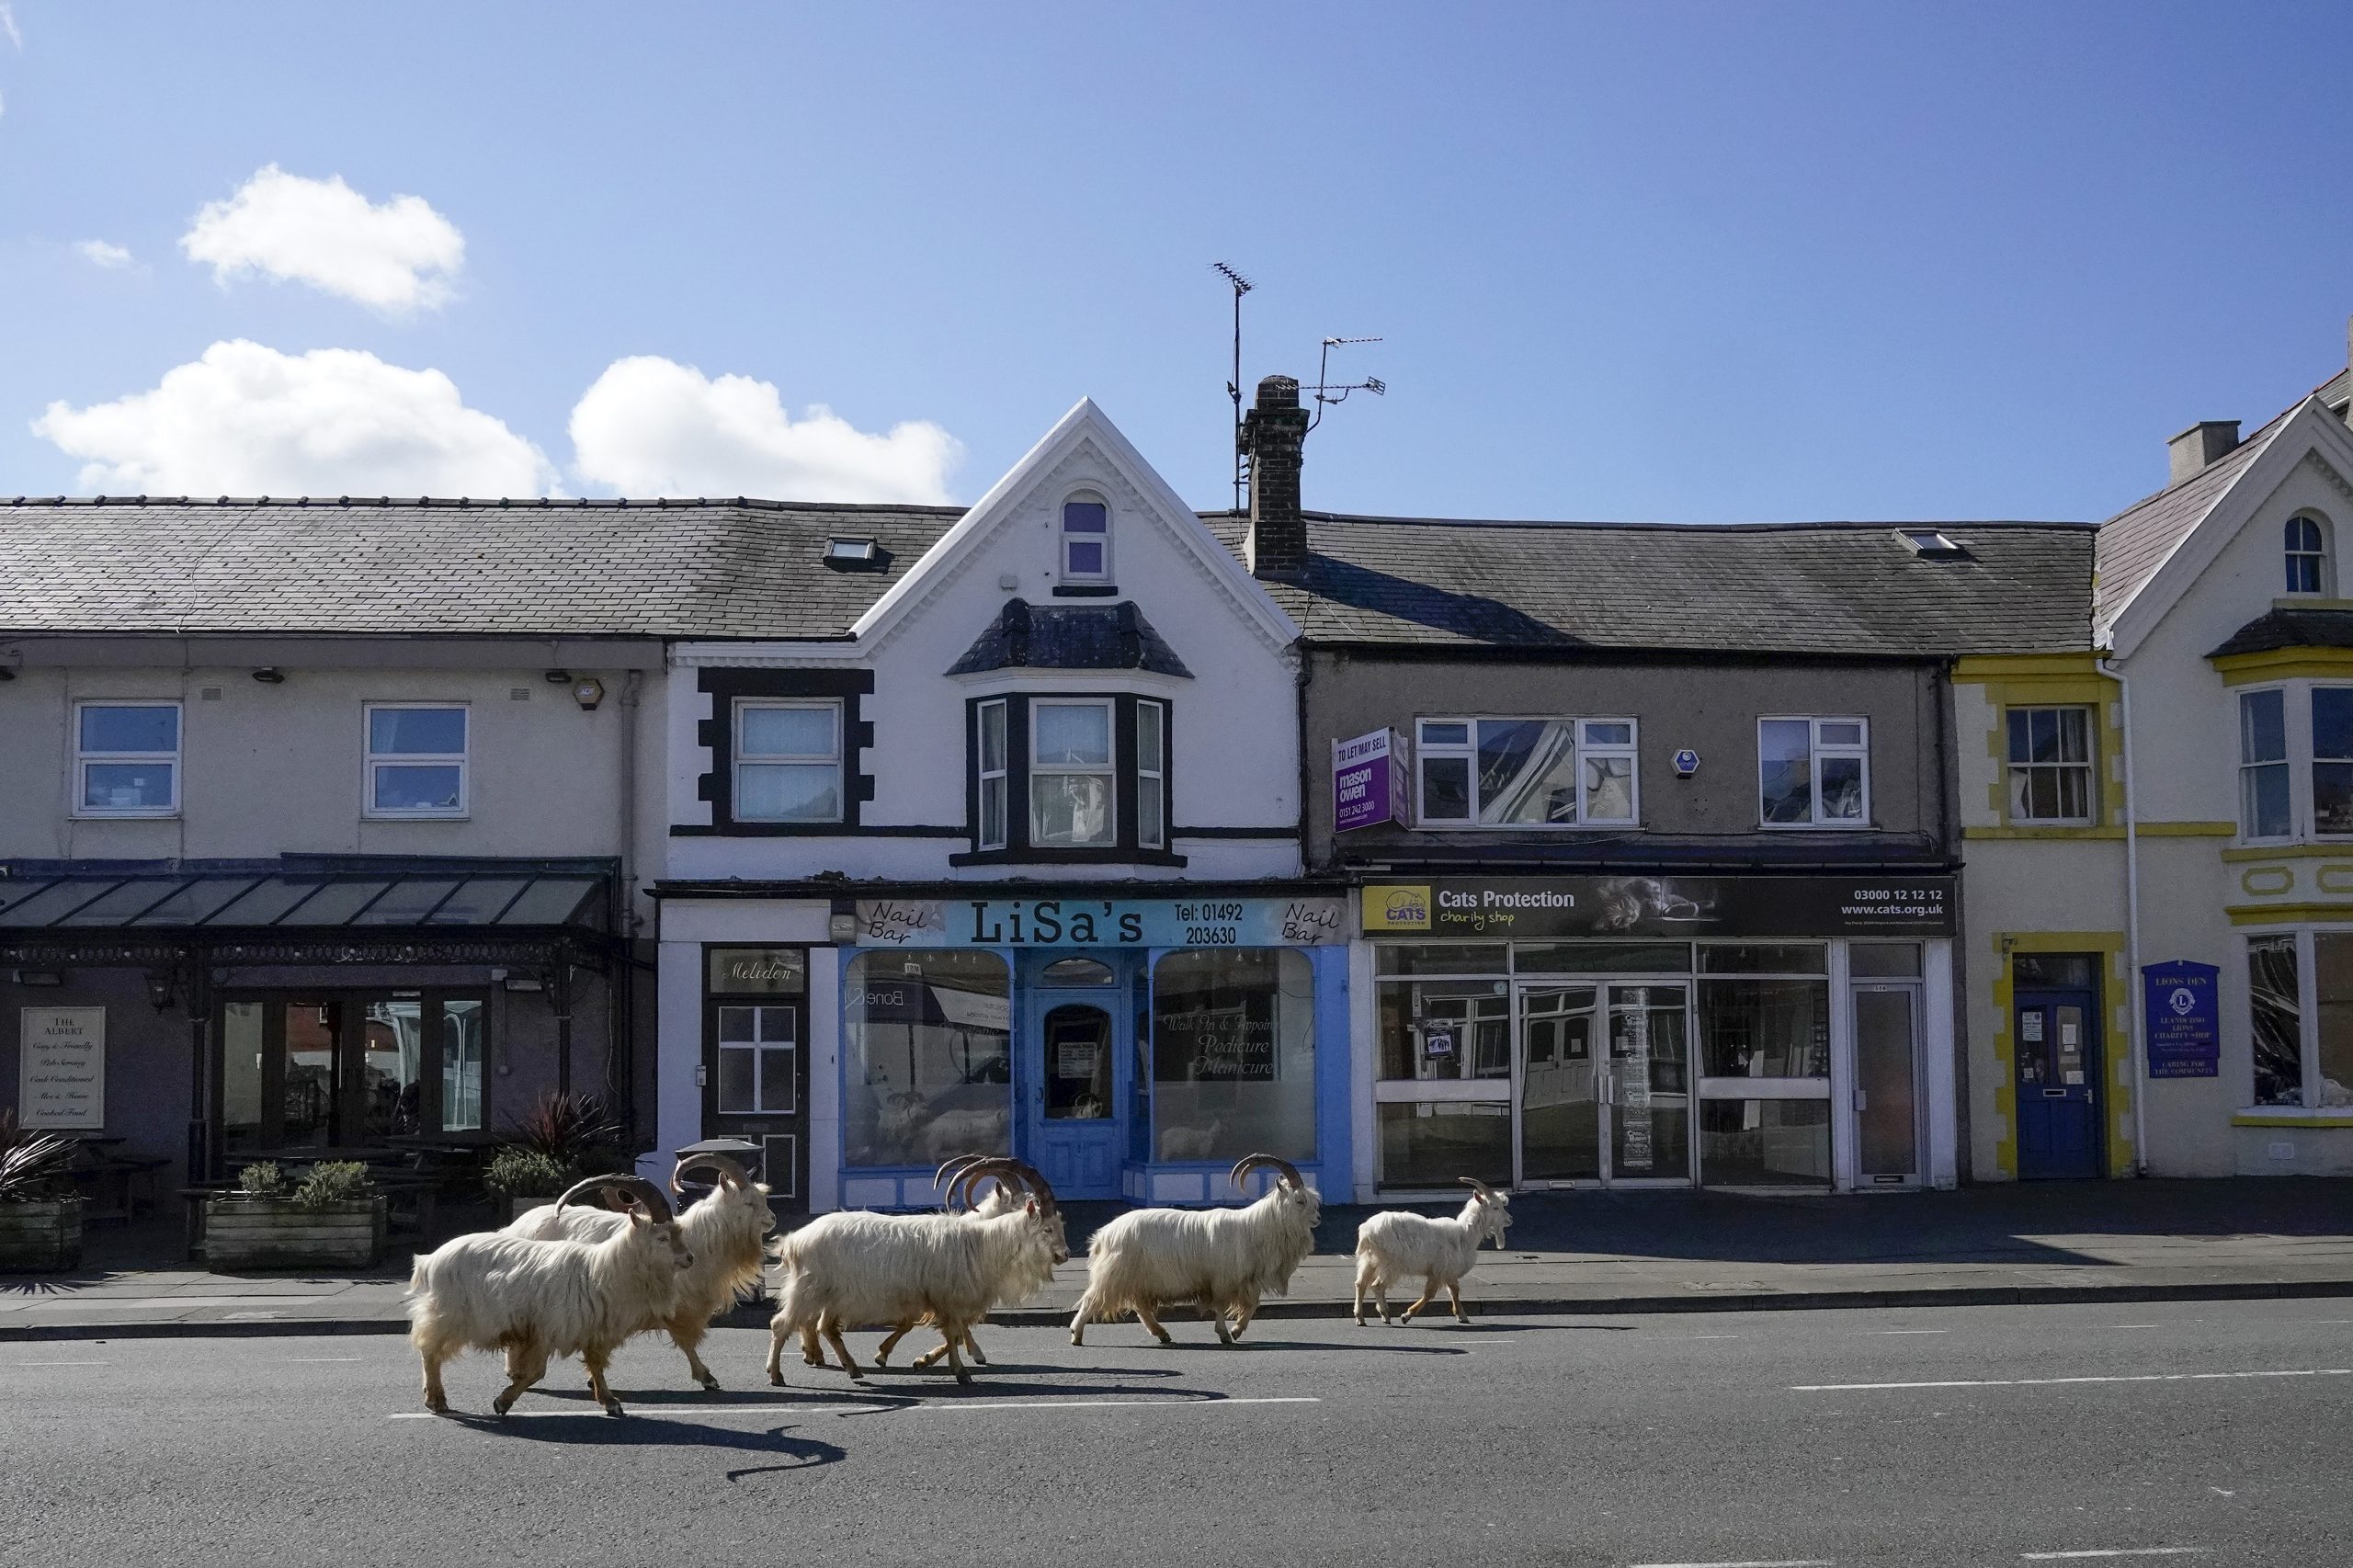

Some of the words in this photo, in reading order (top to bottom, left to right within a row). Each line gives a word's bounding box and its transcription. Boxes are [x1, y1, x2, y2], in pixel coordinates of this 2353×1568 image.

[1338, 749, 1346, 762] TO
[1372, 735, 1386, 751] SELL
[1339, 767, 1371, 790] mason
[1339, 784, 1366, 803] owen
[1339, 807, 1351, 818] 0151
[1351, 804, 1361, 815] 242
[1362, 801, 1375, 812] 3000
[1438, 890, 1478, 908] Cats
[1483, 890, 1574, 908] Protection
[1854, 890, 1890, 900] 03000
[1893, 890, 1907, 900] 12
[1912, 890, 1926, 900] 12
[1928, 890, 1943, 900] 12
[873, 902, 927, 928] Nail
[1175, 903, 1198, 921] Tel:
[1202, 903, 1243, 921] 01492
[1285, 903, 1339, 928] Nail
[1386, 908, 1426, 920] CATS
[1841, 904, 1943, 916] www.cats.org.uk
[971, 902, 1142, 943] LiSa's
[1440, 910, 1484, 931] charity
[1489, 911, 1515, 926] shop
[868, 921, 911, 944] Bar
[1186, 927, 1236, 944] 203630
[1281, 922, 1323, 945] Bar
[2155, 977, 2184, 985] LIONS
[2188, 977, 2207, 985] DEN
[2178, 995, 2187, 1006] L
[55, 1017, 74, 1026] THE
[1163, 1015, 1194, 1031] Walk
[1199, 1014, 1215, 1031] In
[1219, 1015, 1229, 1031] &
[1198, 1034, 1269, 1053] Pedicure
[1194, 1056, 1273, 1075] Manicure
